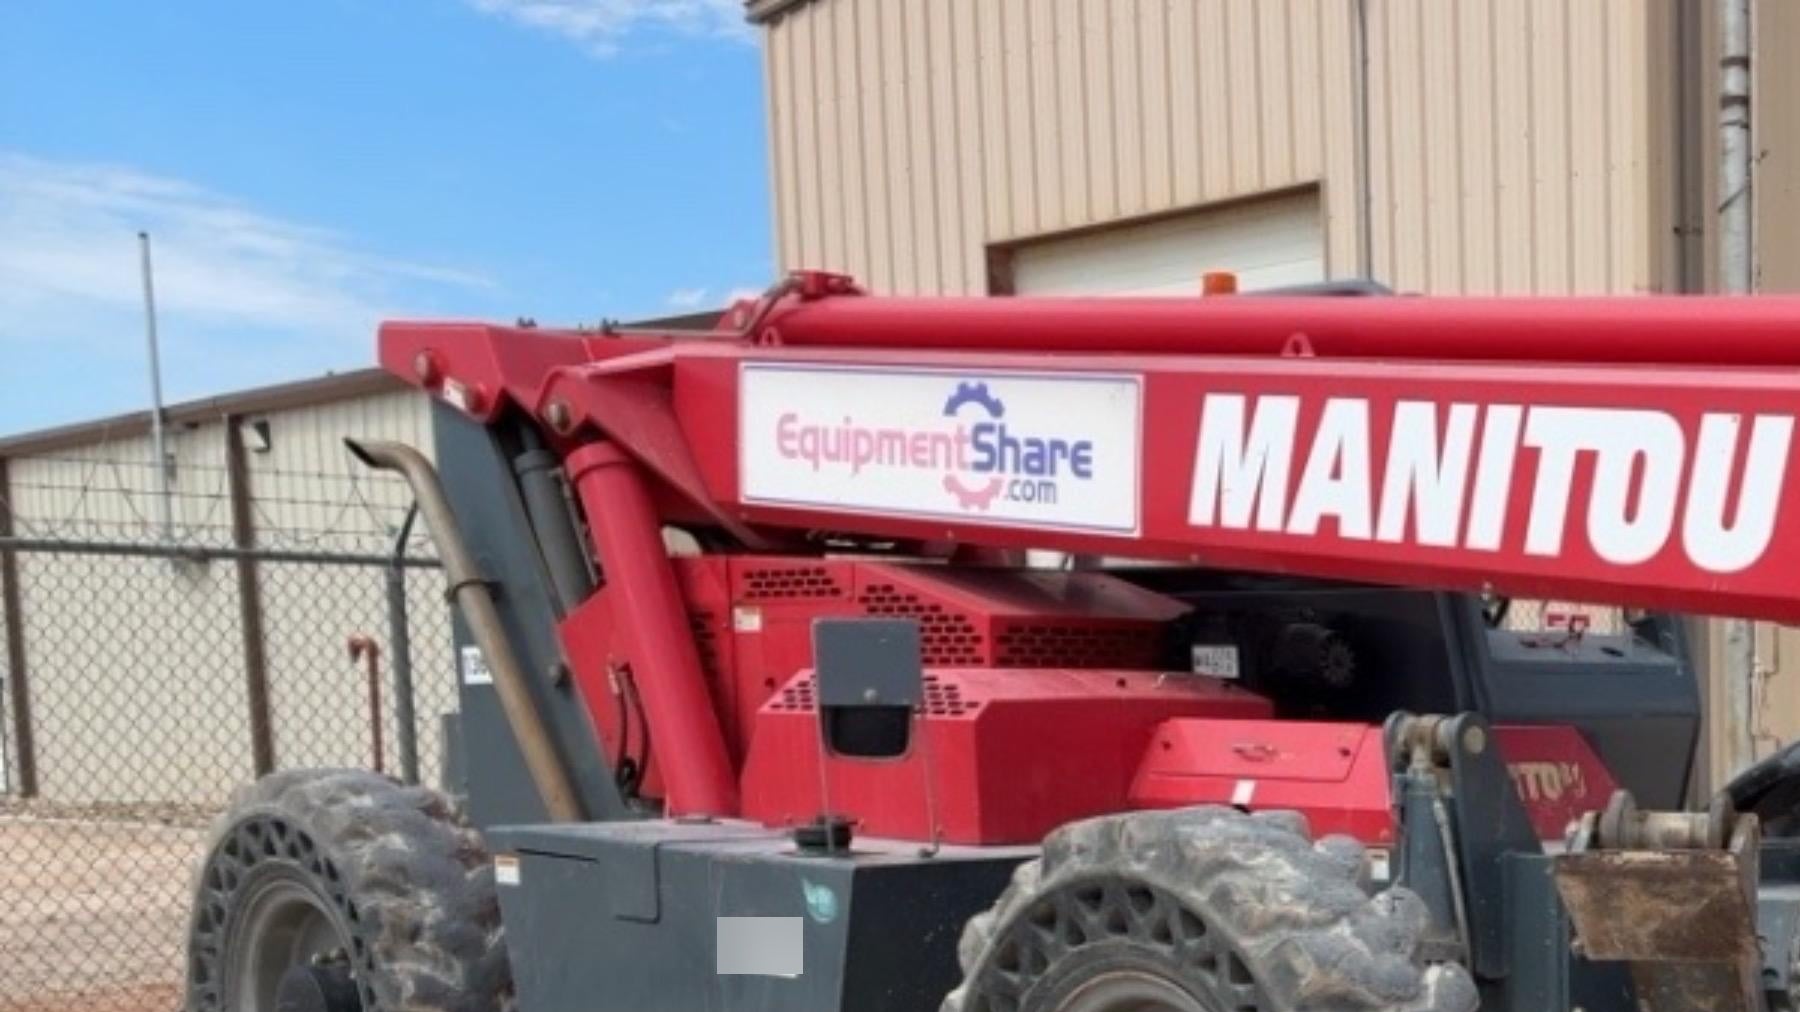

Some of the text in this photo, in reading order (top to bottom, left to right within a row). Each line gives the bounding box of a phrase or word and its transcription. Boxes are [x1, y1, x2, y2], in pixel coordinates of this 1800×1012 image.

[776, 412, 1093, 479] EquipmentShare
[1004, 478, 1057, 504] .com
[1187, 393, 1796, 573] MANITOU
